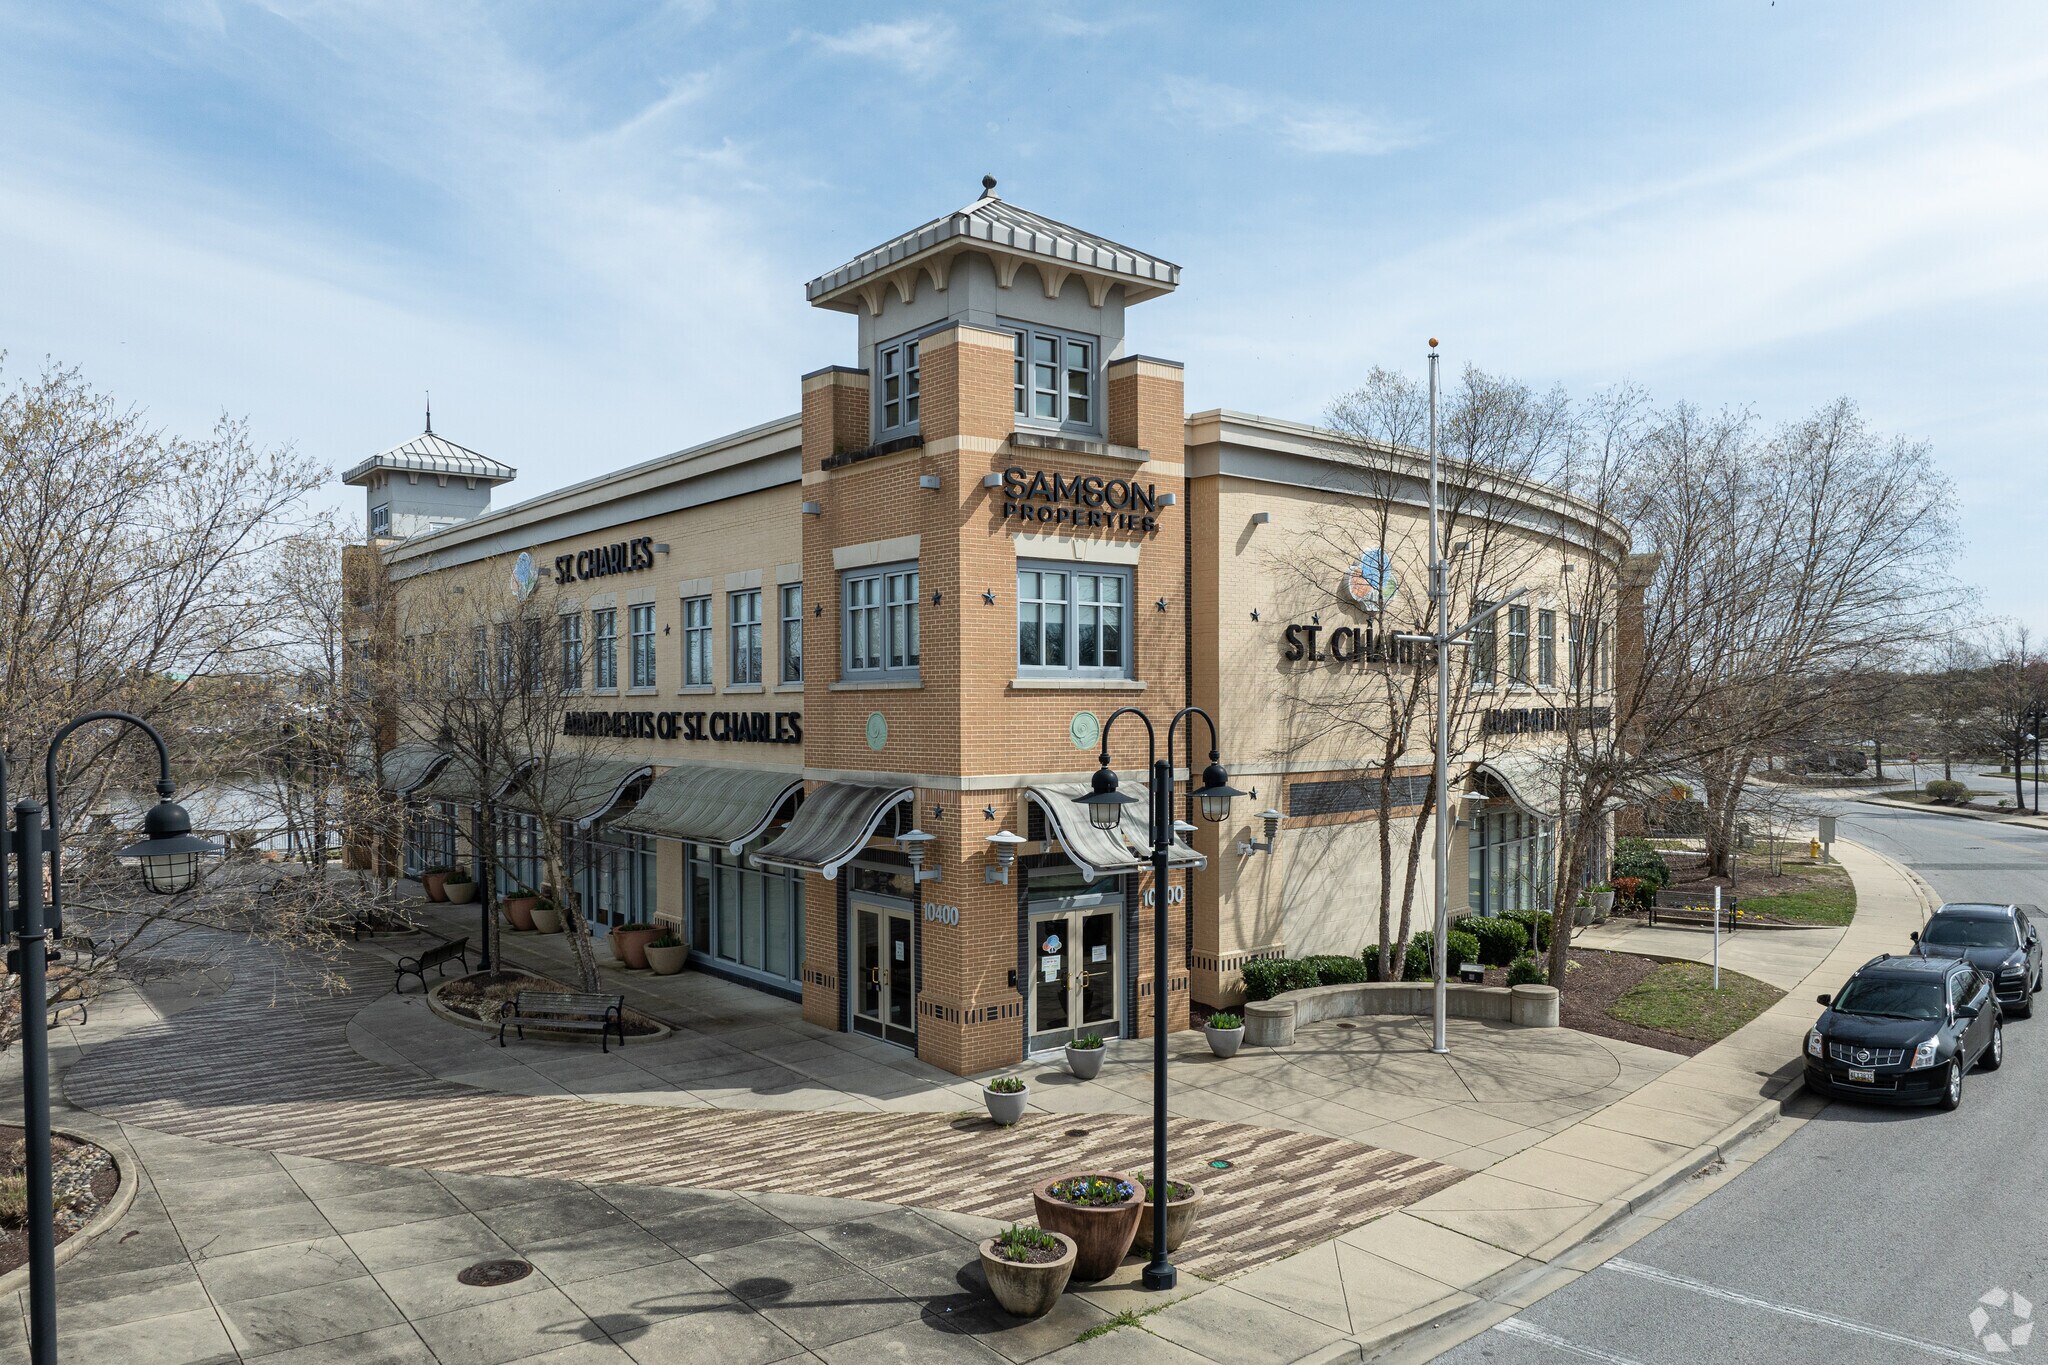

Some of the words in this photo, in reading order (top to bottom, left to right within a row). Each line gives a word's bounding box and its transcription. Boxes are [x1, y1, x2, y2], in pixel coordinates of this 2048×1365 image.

[1004, 466, 1156, 513] SAMSON
[1004, 502, 1156, 532] PROPERTIES
[554, 553, 576, 585] ST.
[576, 536, 653, 581] CHARLES
[1285, 623, 1326, 662] ST.
[562, 711, 656, 739] APARTMENTS
[656, 711, 683, 740] OF
[683, 711, 709, 741] ST.
[708, 711, 802, 744] CHARLES
[1142, 885, 1184, 907] 1000
[923, 901, 960, 926] 10400
